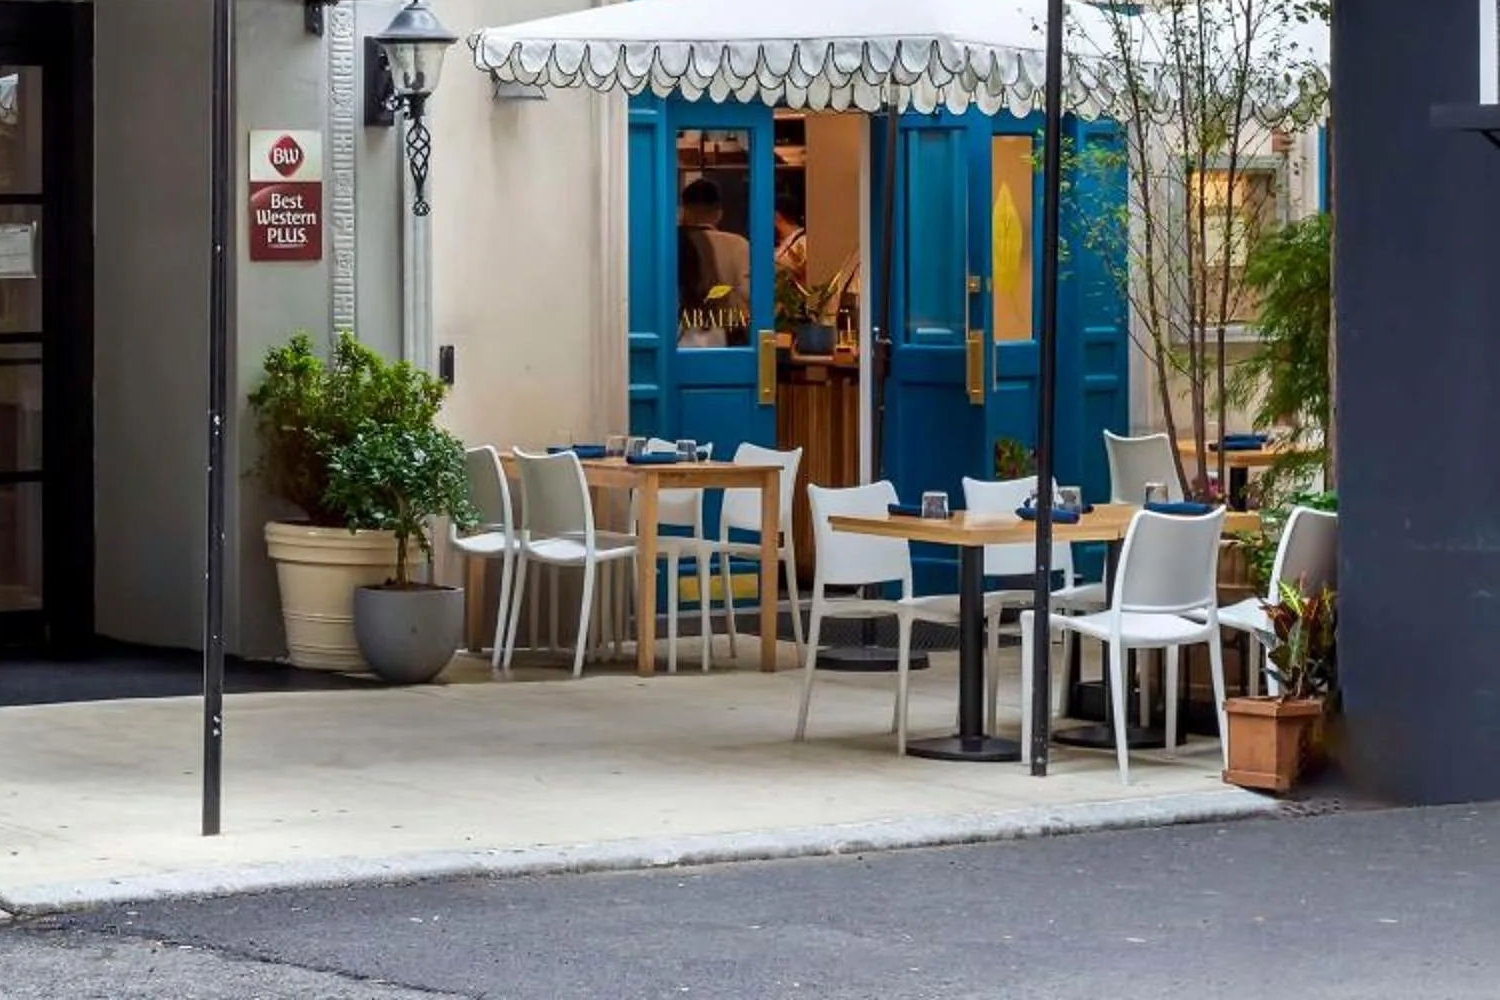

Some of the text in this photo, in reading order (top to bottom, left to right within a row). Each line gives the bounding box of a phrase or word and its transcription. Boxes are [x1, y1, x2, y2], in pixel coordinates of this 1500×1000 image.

[272, 148, 300, 165] BW
[271, 193, 304, 209] Best
[256, 209, 317, 225] Western
[267, 227, 307, 243] PLUS
